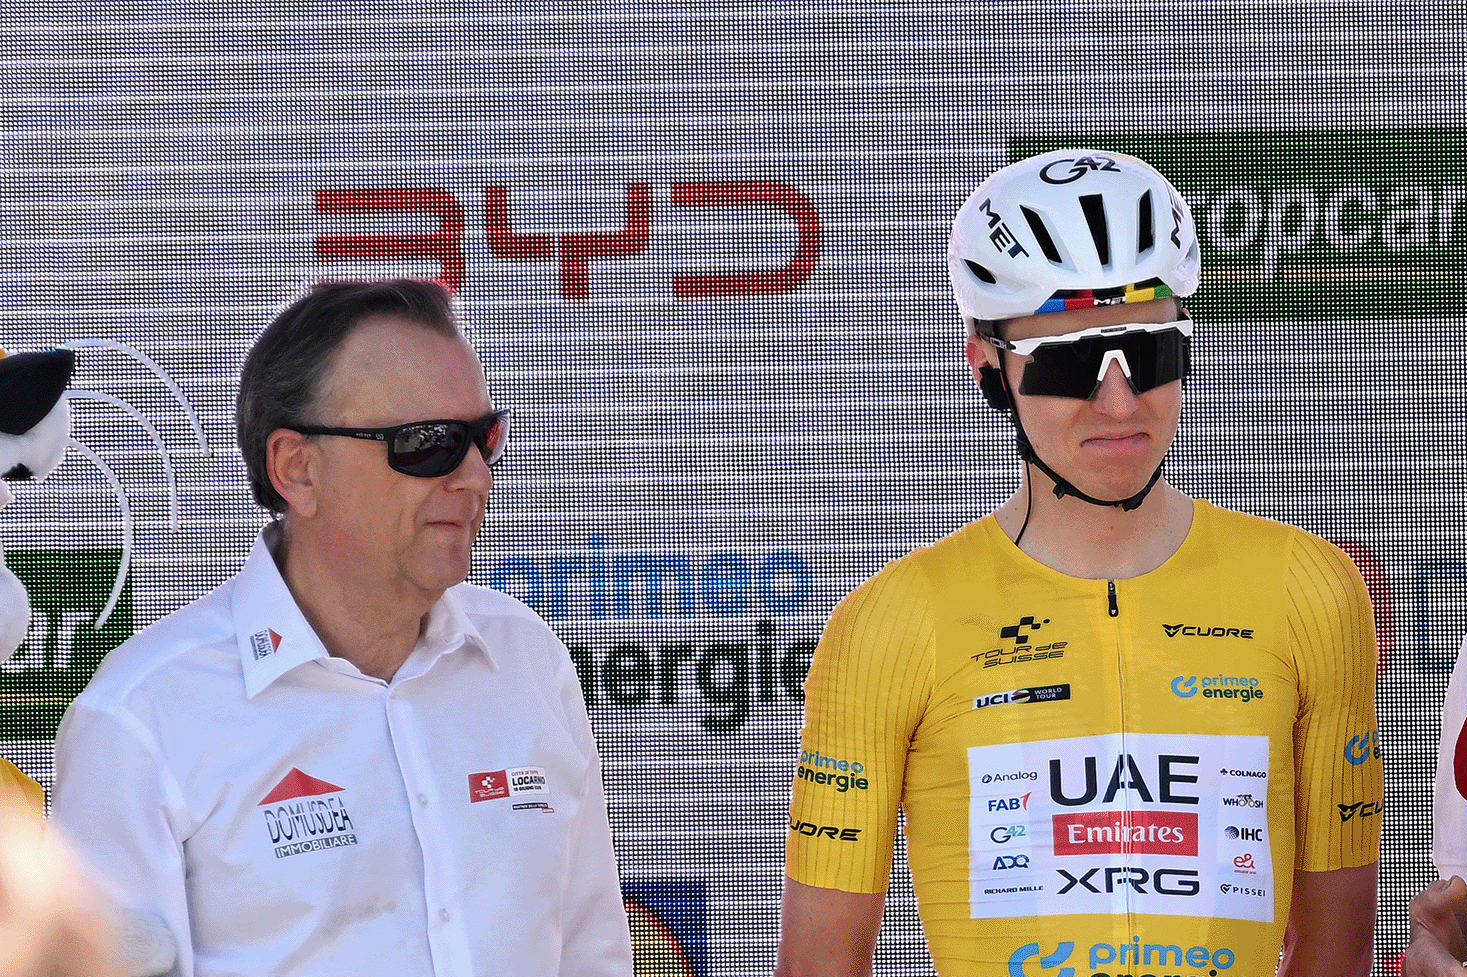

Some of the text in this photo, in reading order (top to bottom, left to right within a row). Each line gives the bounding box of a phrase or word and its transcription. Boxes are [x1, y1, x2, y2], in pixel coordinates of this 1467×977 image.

[979, 198, 1030, 258] MET
[1182, 626, 1254, 639] CUORE
[970, 645, 1032, 661] TOUR
[983, 650, 1064, 668] SUISSE
[1202, 674, 1259, 688] primeo
[1034, 687, 1063, 695] WORLD
[1203, 686, 1264, 703] energie
[977, 693, 1008, 708] UCI
[800, 750, 864, 773] primeo
[512, 776, 546, 786] LOCARNO
[797, 766, 869, 792] energie
[993, 771, 1038, 782] Analog
[1049, 754, 1200, 807] UAE
[1229, 769, 1267, 778] COLNAGO
[988, 798, 1020, 812] FAB
[264, 797, 354, 844] DOMUSDEA
[990, 825, 1026, 844] G42
[1067, 822, 1184, 844] Emirates
[1241, 827, 1263, 842] IHC
[275, 834, 357, 858] IMMOBILIARE
[992, 854, 1030, 870] ADQ
[1055, 867, 1200, 896] XRG
[984, 887, 1017, 895] RICHARD
[1233, 886, 1266, 897] PISSEI
[1089, 935, 1236, 970] primeo
